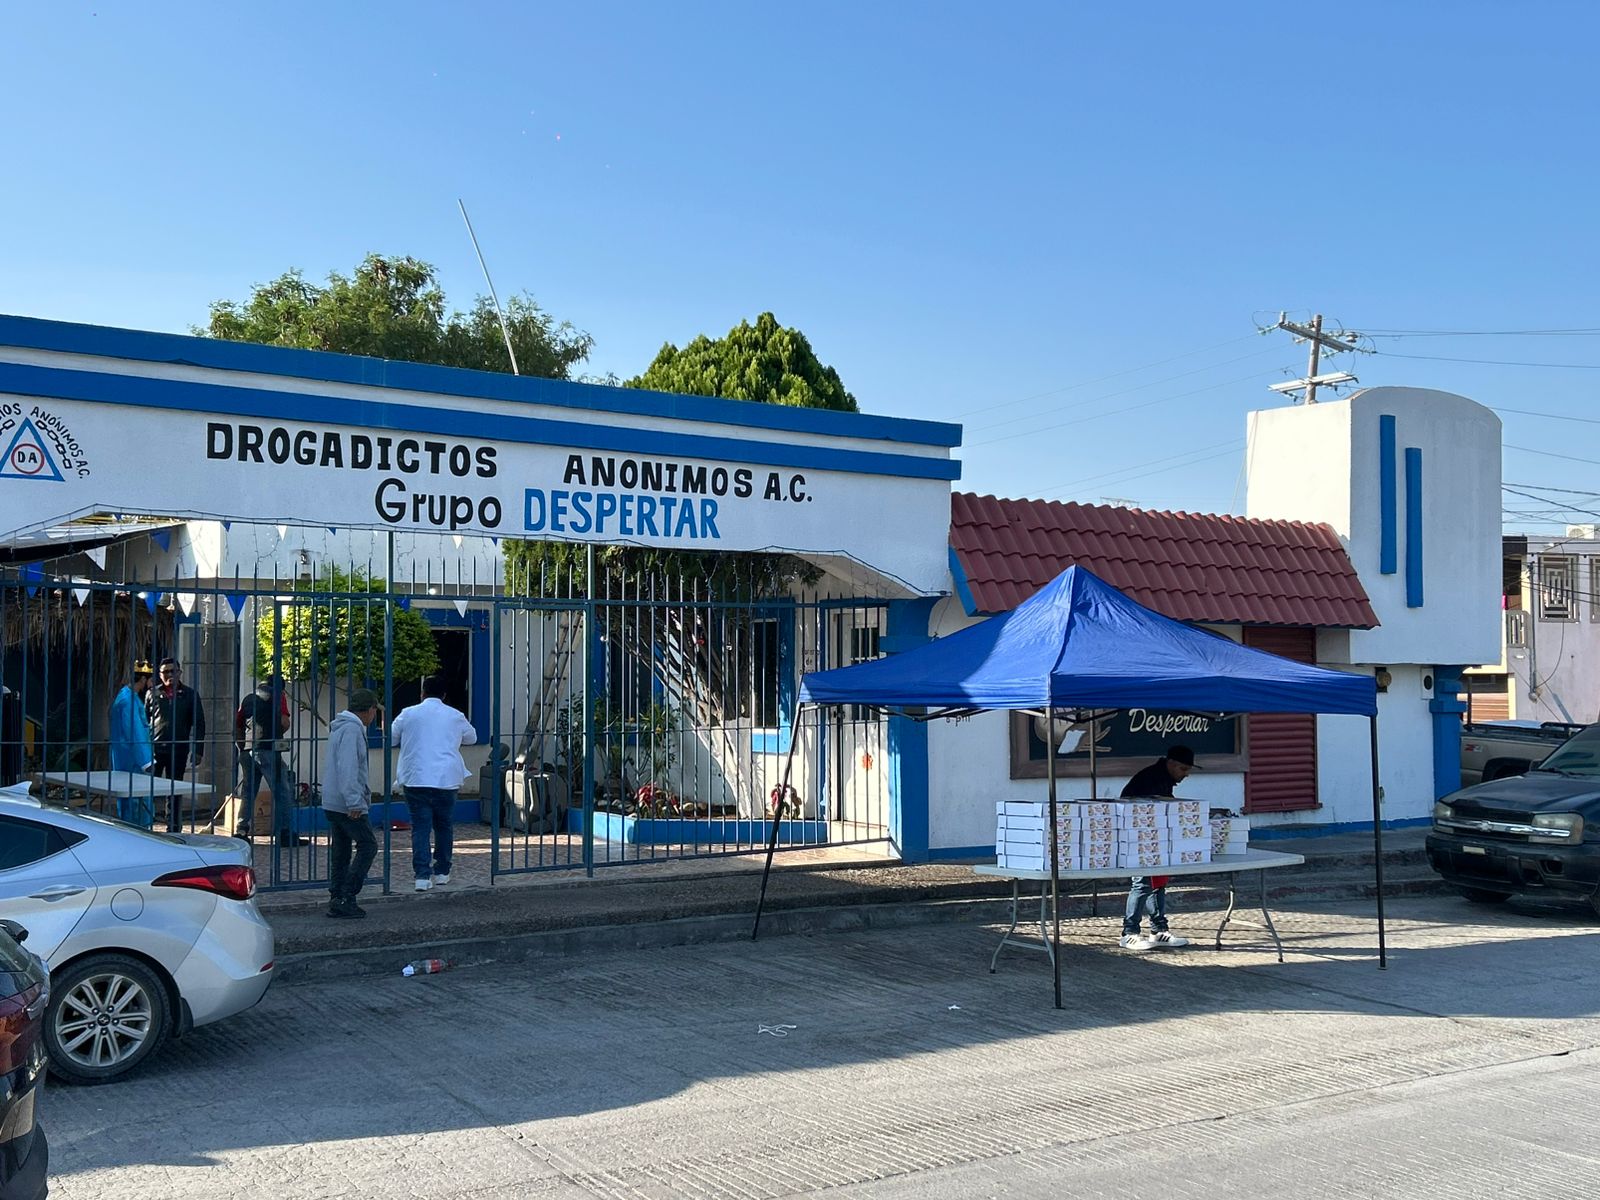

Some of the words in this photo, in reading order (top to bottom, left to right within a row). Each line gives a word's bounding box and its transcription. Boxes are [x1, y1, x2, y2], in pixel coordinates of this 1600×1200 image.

[206, 422, 498, 478] DROGADICTOS
[563, 454, 753, 498] ANONIMOS
[374, 477, 502, 531] Grupo
[523, 488, 721, 539] DESPERTAR
